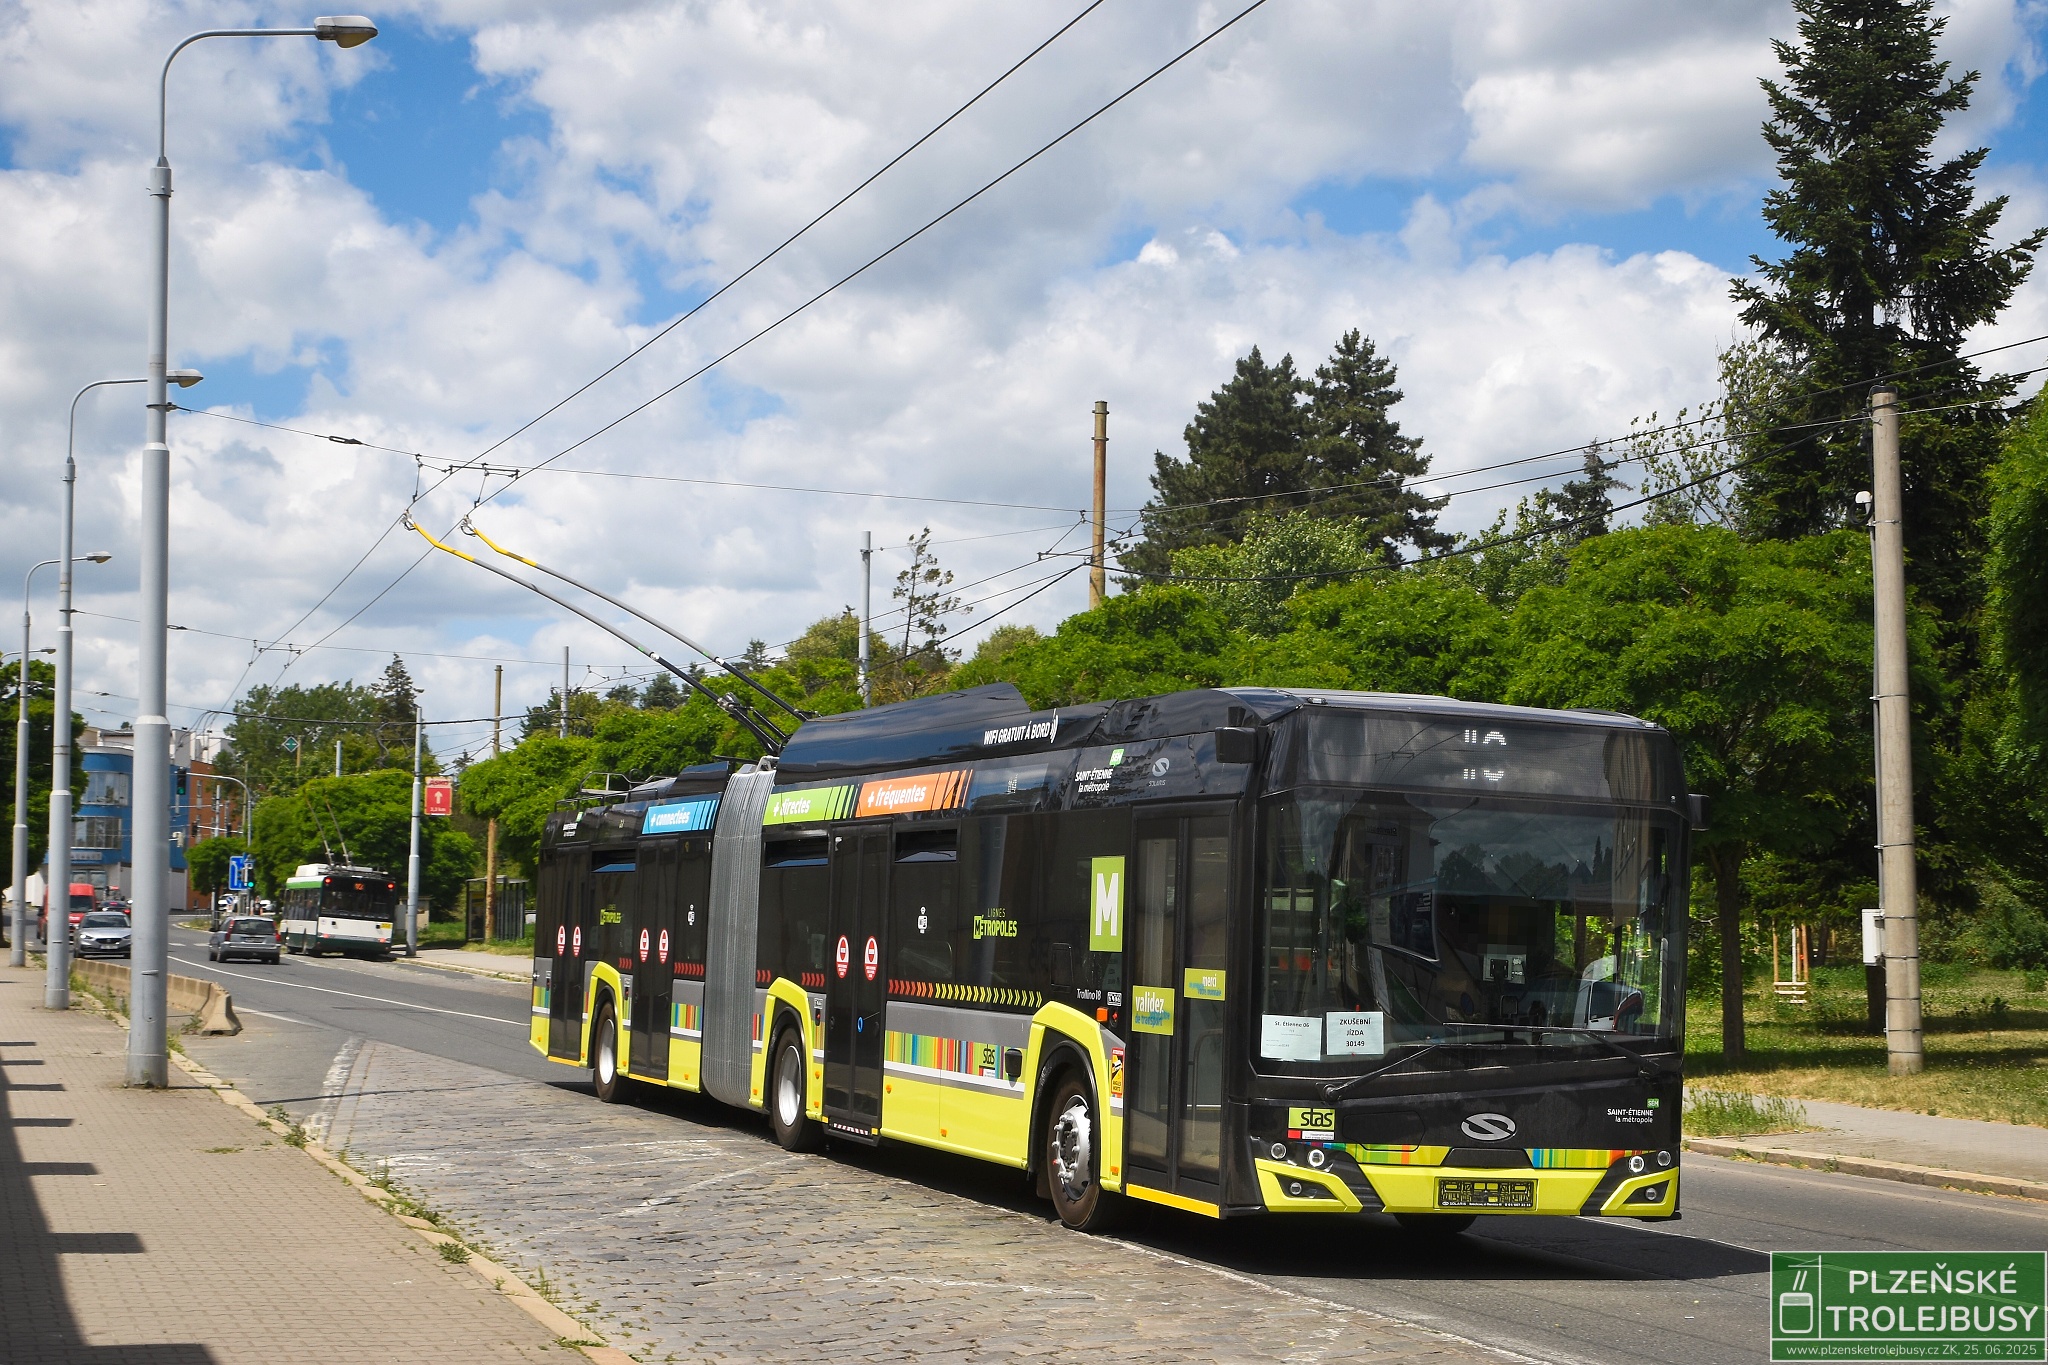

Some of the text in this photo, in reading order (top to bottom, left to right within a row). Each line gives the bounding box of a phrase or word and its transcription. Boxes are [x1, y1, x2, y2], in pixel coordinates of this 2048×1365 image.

[984, 729, 999, 745] WIFI
[998, 725, 1026, 744] GRATUIT
[1030, 721, 1051, 739] BORD
[1075, 767, 1114, 782] SAINT-ÉTIENNE
[1084, 780, 1110, 794] métropole
[875, 783, 927, 810] fréquentes
[780, 797, 811, 815] directes
[656, 806, 691, 825] connectées
[1095, 872, 1119, 936] M
[987, 907, 1006, 918] LIGNES
[1202, 973, 1217, 988] merci
[1077, 988, 1095, 1000] Trollino
[1095, 990, 1102, 1001] 18
[1135, 991, 1165, 1014] validez
[1339, 1017, 1371, 1026] ZKUŠEBNÍ
[983, 1044, 995, 1065] stas
[1300, 1107, 1333, 1128] stas
[1607, 1107, 1654, 1117] SAINT-ÉTIENNE
[1615, 1115, 1654, 1125] la métropole
